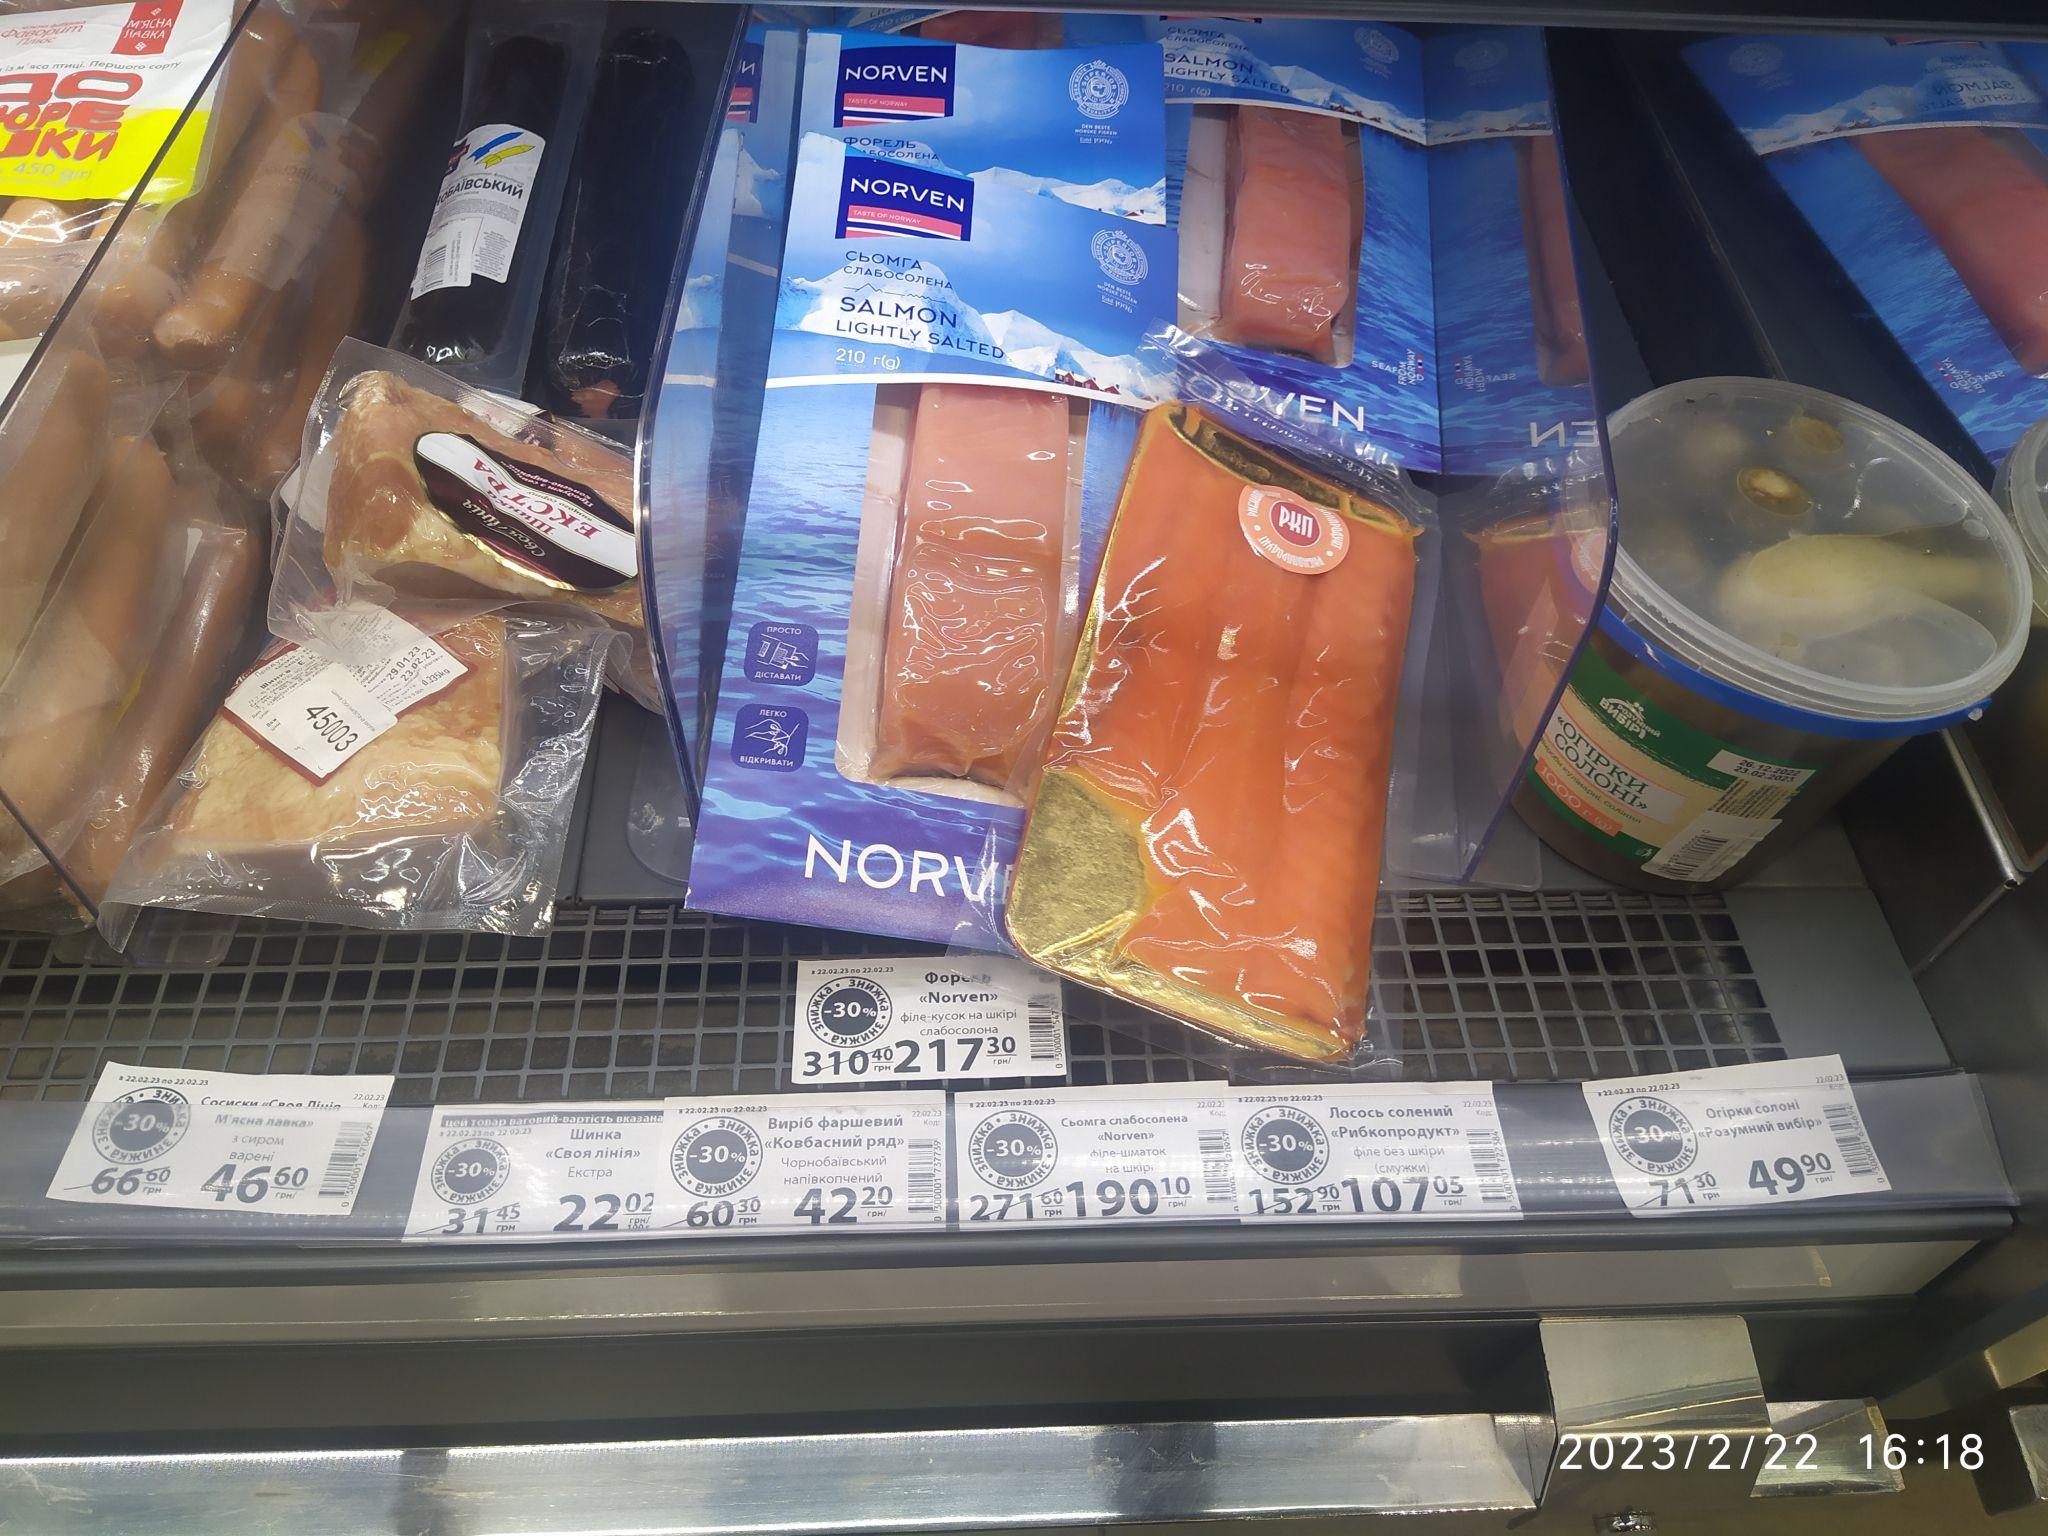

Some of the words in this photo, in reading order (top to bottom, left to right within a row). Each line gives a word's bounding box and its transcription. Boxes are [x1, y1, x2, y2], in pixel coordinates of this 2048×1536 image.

[90, 61, 147, 71] Першого
[149, 61, 181, 71] сорту
[1164, 54, 1253, 73] SALMON
[845, 65, 947, 83] NORVEN
[1232, 74, 1290, 94] SALTED
[848, 98, 868, 106] TASTE
[879, 99, 908, 107] NORWAY
[844, 136, 916, 149] ФОРЕЛЬ
[850, 177, 965, 212] NORVEN
[853, 209, 877, 218] TASTE
[889, 214, 921, 224] NORWAY
[845, 250, 923, 271] СЬОМГА
[843, 265, 953, 290] СЛАБОСОЛЕНА
[839, 296, 957, 329] SALMON
[835, 318, 921, 342] LIGHTLY
[927, 331, 1005, 360] SALTED
[835, 348, 865, 364] 210
[1398, 361, 1407, 385] FROM
[1407, 348, 1416, 385] NORWAY
[473, 458, 602, 540] ЕКСТРА
[486, 490, 555, 535] Шинка
[1279, 506, 1313, 538] РКП
[767, 627, 801, 635] ПРОСТО
[387, 646, 421, 681] 29.01.23
[400, 648, 436, 682] 23.02.23
[755, 672, 801, 681] ДІСТАВАТИ
[760, 710, 787, 718] ЛЕГКО
[305, 706, 358, 752] 45003
[740, 756, 793, 767] ВІДКРИВАТИ
[1558, 716, 1649, 794] «ОГІРКИ
[1554, 733, 1647, 810] СОЛОНІ»
[1739, 760, 1801, 777] 26.12.2022
[1541, 766, 1581, 808] 1000
[804, 833, 1015, 907] NORV
[920, 992, 998, 1004] «Norven»
[824, 1002, 876, 1018] -30%
[900, 1010, 965, 1022] філе-кусок
[968, 1012, 982, 1020] на
[985, 1009, 1017, 1020] шкірі
[920, 1025, 998, 1036] слабосолона
[872, 1048, 893, 1060] 40
[894, 1039, 983, 1073] 217
[987, 1037, 1016, 1054] 30
[803, 1051, 869, 1077] 310
[874, 1064, 891, 1072] грн
[734, 1105, 767, 1113] 22.02.23
[1330, 1107, 1384, 1118] Лосось
[1388, 1106, 1453, 1117] солений
[1705, 1106, 1752, 1118] Огірки
[1756, 1099, 1800, 1113] солоні
[470, 1118, 506, 1127] товар
[768, 1118, 814, 1131] Виріб
[817, 1116, 903, 1130] фаршевий
[1061, 1117, 1106, 1127] Сьомга
[1109, 1115, 1188, 1125] слабосолена
[1699, 1121, 1775, 1138] «Розумний
[1778, 1118, 1822, 1132] вибір»
[241, 1135, 284, 1147] сиром
[570, 1129, 622, 1140] Шинка
[1098, 1131, 1154, 1141] «Norven»
[1331, 1127, 1459, 1139] «Рибкопродукт»
[765, 1136, 862, 1149] «Ковбасний
[866, 1138, 904, 1149] ряд»
[987, 1140, 1041, 1157] -30%
[1261, 1135, 1313, 1152] -30%
[229, 1150, 274, 1162] варені
[546, 1147, 592, 1159] «Своя
[594, 1148, 641, 1159] лінія»
[690, 1145, 746, 1163] -30%
[1090, 1148, 1166, 1158] філе-шматок
[1354, 1146, 1381, 1158] філе
[1384, 1147, 1405, 1156] без
[1408, 1146, 1445, 1158] шкіри
[448, 1162, 495, 1177] -30%
[781, 1156, 887, 1168] Чорнобаївський
[1375, 1163, 1430, 1175] (смужки)
[91, 1167, 139, 1195] 66
[146, 1167, 171, 1182] 60
[568, 1166, 613, 1180] Екстра
[784, 1173, 883, 1185] напівкопчений
[1697, 1173, 1716, 1187] 30
[1748, 1158, 1805, 1195] 49
[1801, 1153, 1832, 1172] 90
[143, 1186, 161, 1195] грн
[201, 1164, 269, 1203] 46
[273, 1166, 308, 1187] 60
[1066, 1179, 1158, 1217] 190
[1161, 1177, 1190, 1195] 10
[1248, 1187, 1316, 1214] 152
[1319, 1186, 1339, 1200] 90
[1341, 1177, 1429, 1212] 107
[1433, 1177, 1464, 1193] 05
[1649, 1179, 1694, 1206] 71
[1703, 1190, 1720, 1200] грн
[496, 1205, 521, 1220] 45
[553, 1194, 621, 1231] 22
[737, 1198, 761, 1212] 30
[793, 1188, 857, 1225] 42
[863, 1186, 893, 1206] 20
[970, 1193, 1034, 1220] 271
[1044, 1208, 1062, 1216] грн
[442, 1208, 489, 1235] 31
[686, 1201, 734, 1227] 60
[739, 1216, 757, 1224] грн
[496, 1224, 516, 1232] грн
